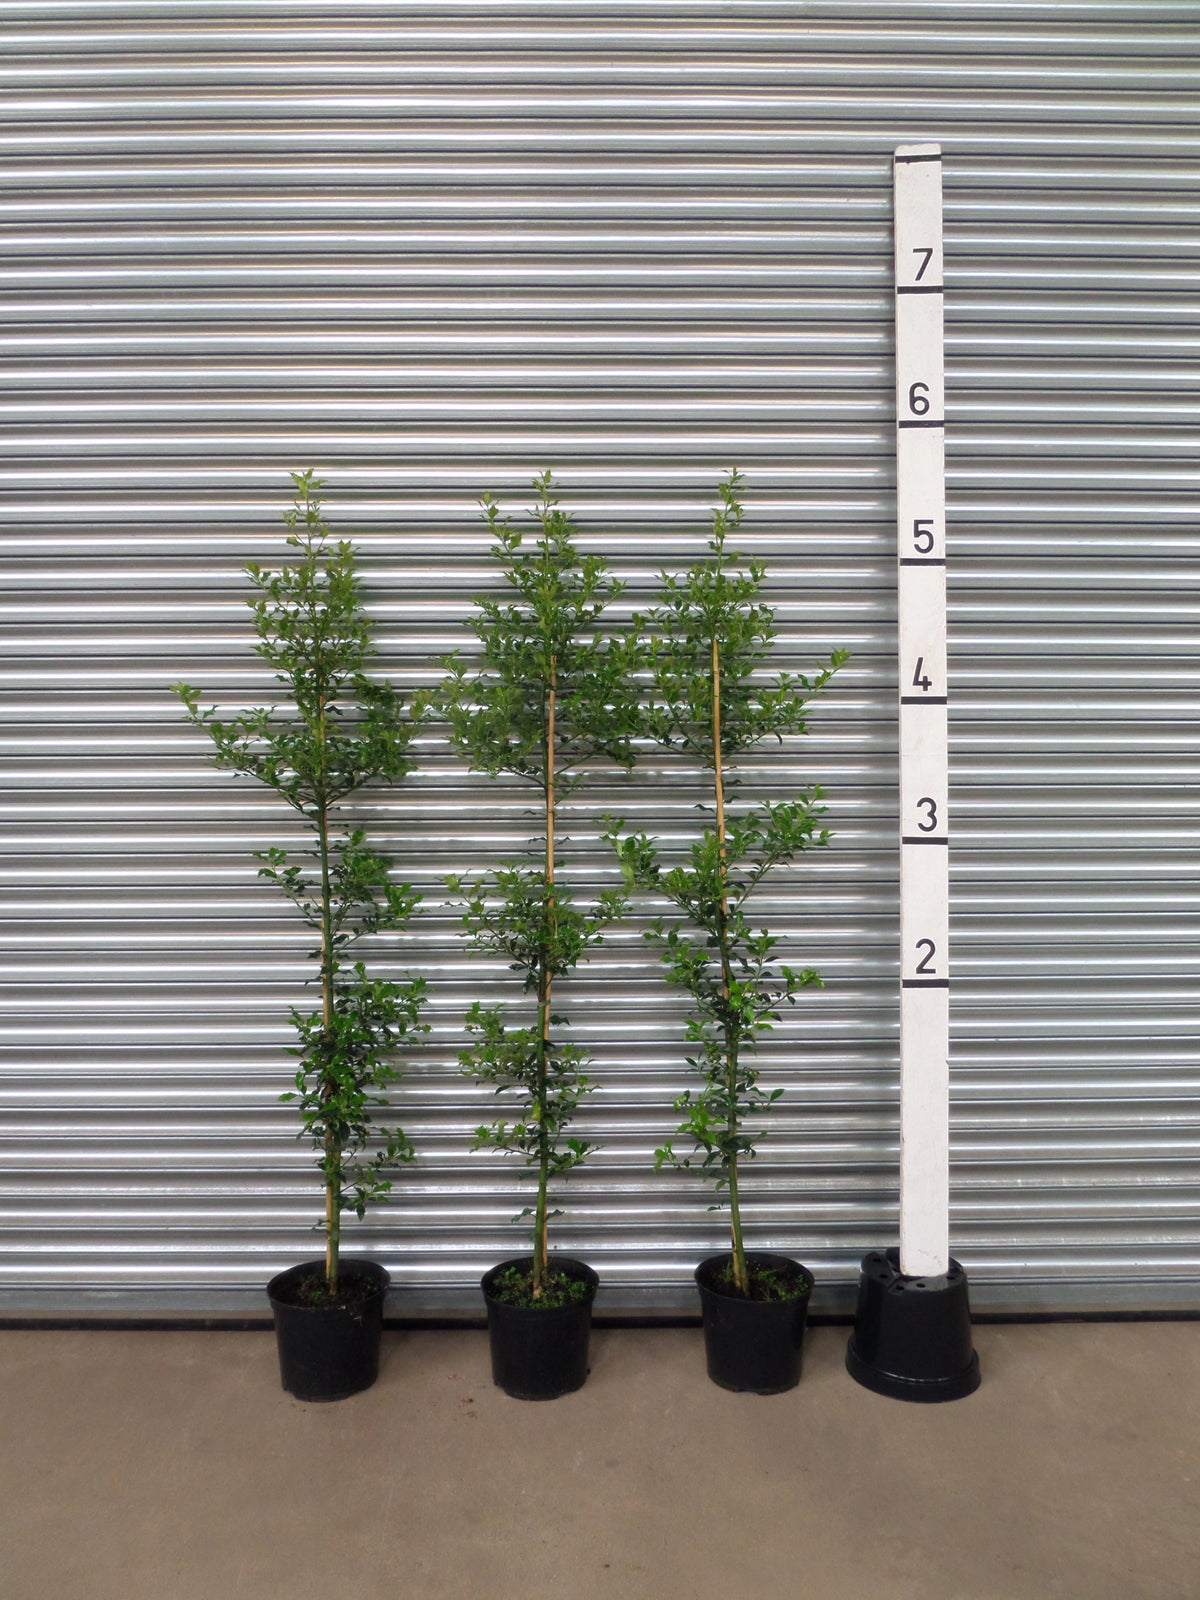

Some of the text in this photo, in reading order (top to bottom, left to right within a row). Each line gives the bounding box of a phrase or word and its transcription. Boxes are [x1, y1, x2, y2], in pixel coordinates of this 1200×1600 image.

[912, 248, 933, 281] 7
[909, 382, 930, 416] 6
[913, 519, 934, 554] 5
[912, 657, 933, 692] 4
[916, 797, 938, 832] 3
[915, 938, 936, 974] 2
